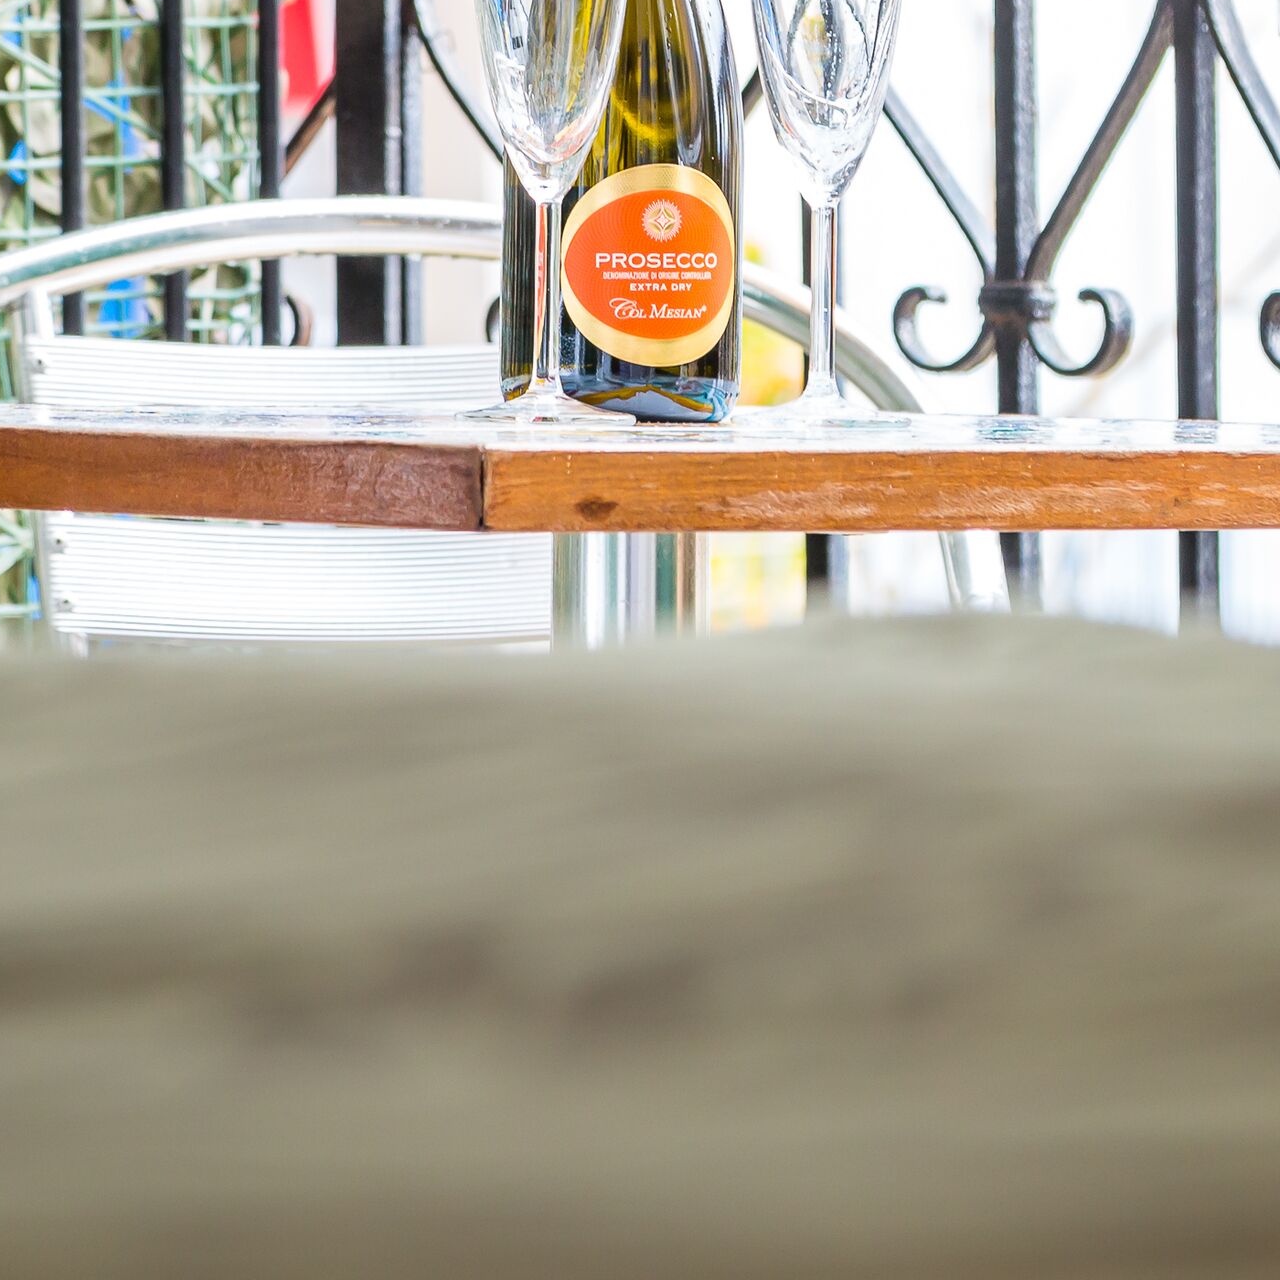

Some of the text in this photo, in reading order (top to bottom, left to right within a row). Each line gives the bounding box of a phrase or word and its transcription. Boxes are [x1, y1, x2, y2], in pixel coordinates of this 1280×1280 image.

[595, 252, 718, 269] PROSECCO
[629, 283, 692, 291] EXTRA DRY
